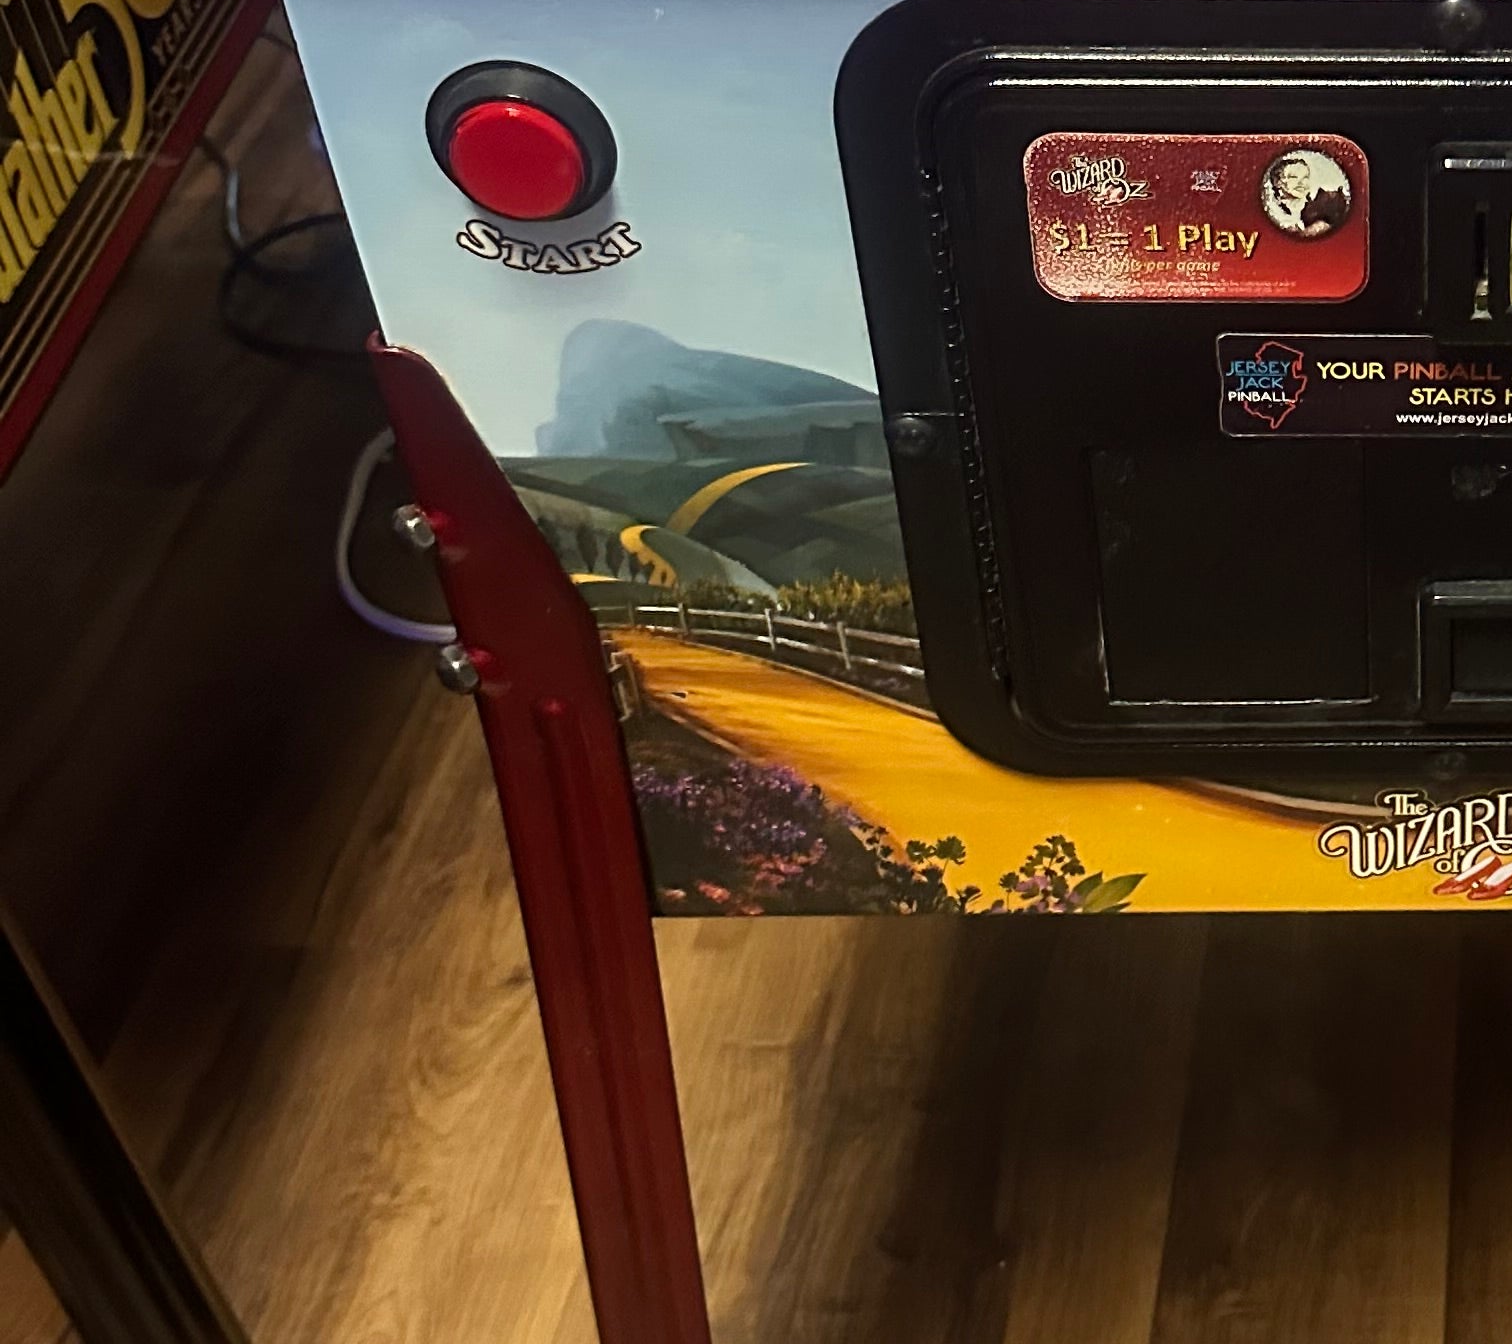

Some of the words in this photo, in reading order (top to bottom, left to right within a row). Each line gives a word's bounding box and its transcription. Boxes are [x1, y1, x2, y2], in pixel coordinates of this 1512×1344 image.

[1050, 157, 1126, 194] WIZARD
[456, 219, 642, 275] START
[1178, 223, 1260, 259] Play
[1226, 361, 1291, 376] JERSEY
[1317, 361, 1386, 380] YOUR
[1394, 361, 1500, 380] PINBALL
[1236, 376, 1284, 389] JACK
[1228, 390, 1291, 403] PINBALL
[1408, 387, 1497, 406] STARTS
[1384, 793, 1429, 816] The
[1436, 849, 1464, 874] of
